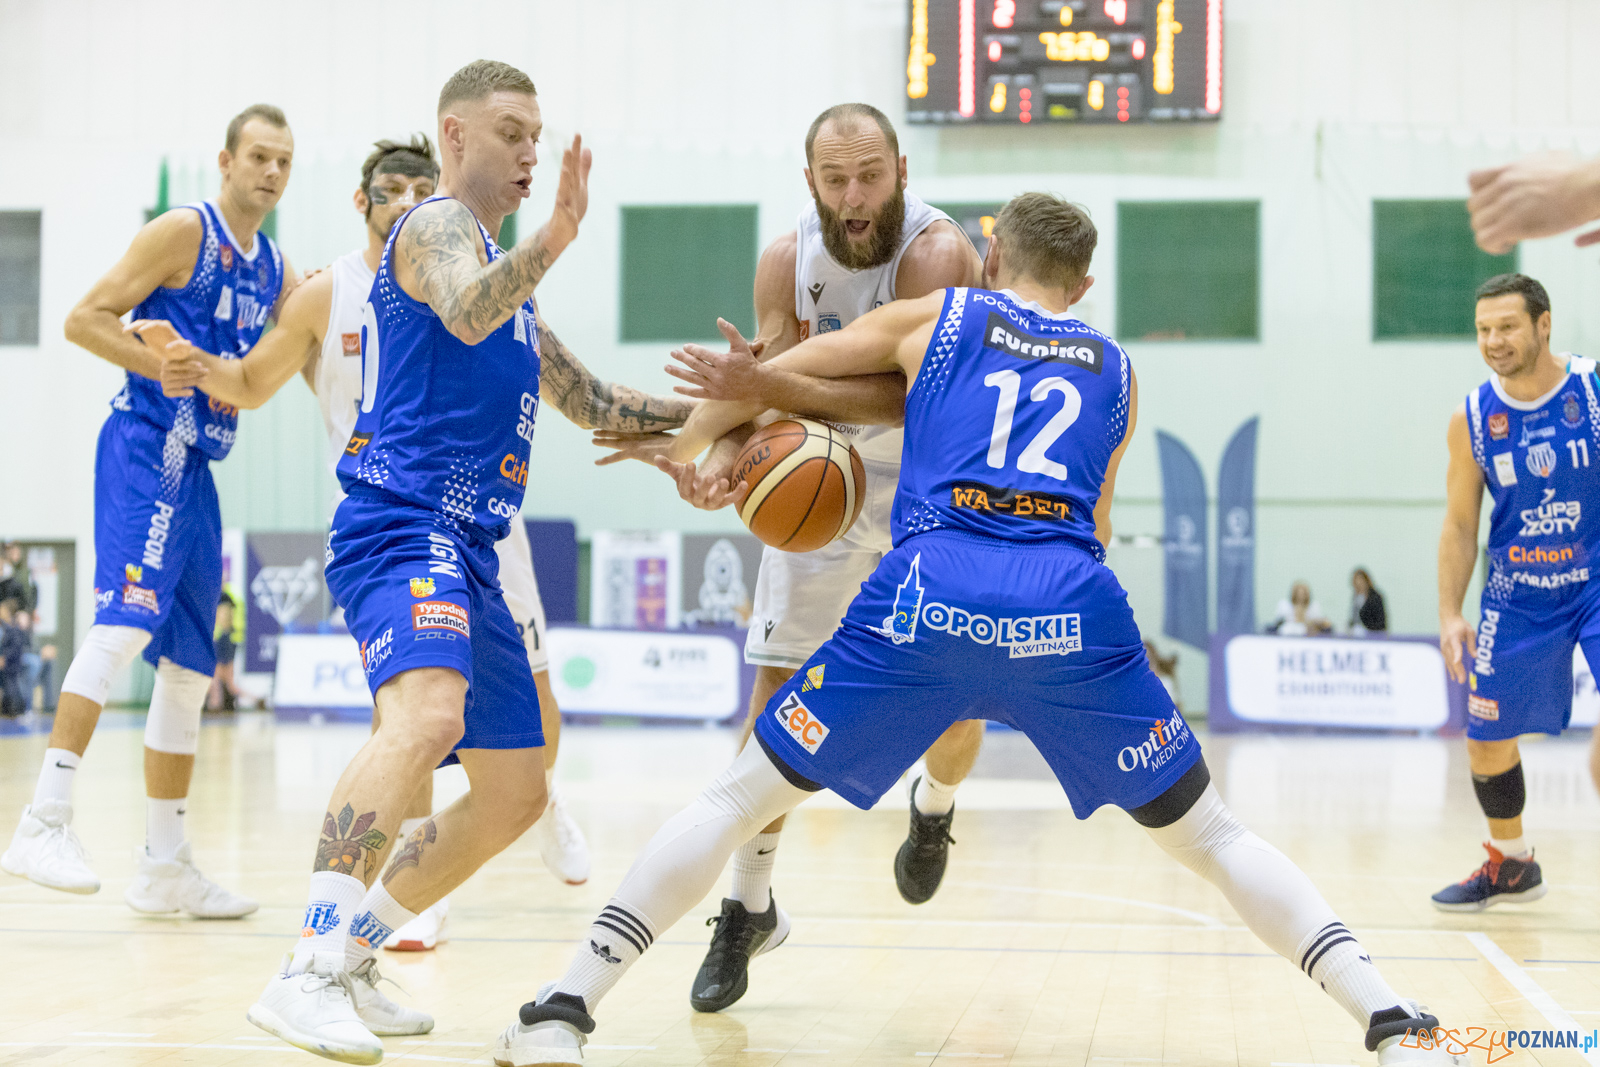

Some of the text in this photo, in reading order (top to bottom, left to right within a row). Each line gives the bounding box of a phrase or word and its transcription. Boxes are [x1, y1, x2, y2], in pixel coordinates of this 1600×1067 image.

[984, 369, 1082, 481] 12
[1566, 438, 1590, 469] 11
[418, 603, 468, 621] Tygodnik
[419, 616, 468, 634] Prudnicki
[922, 602, 1080, 645] OPOLSKIE
[1013, 640, 1079, 655] KWITNĄCE
[779, 695, 823, 745] zec
